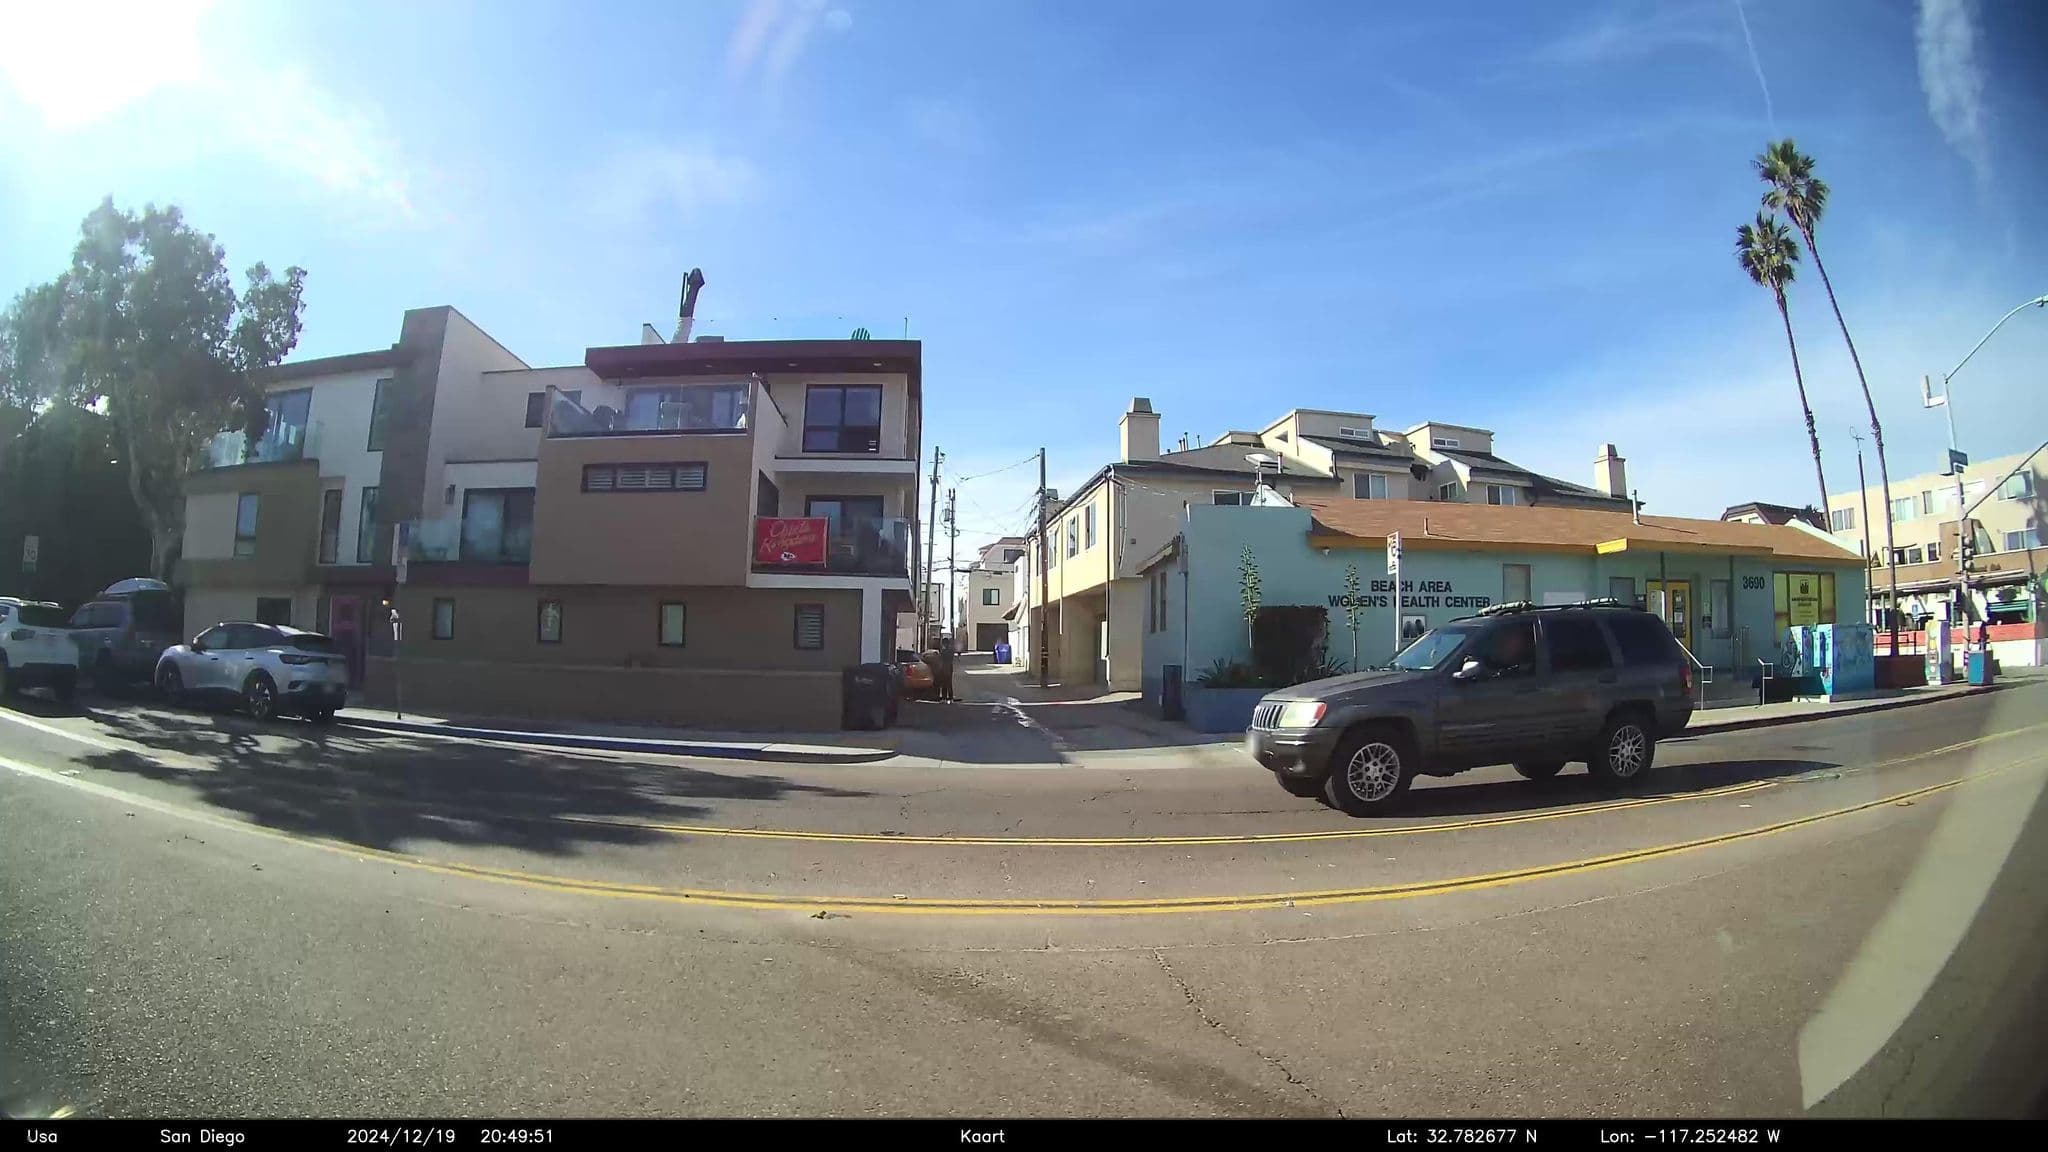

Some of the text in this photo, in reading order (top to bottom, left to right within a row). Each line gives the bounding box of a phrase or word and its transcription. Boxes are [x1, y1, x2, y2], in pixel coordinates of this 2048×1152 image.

[1418, 580, 1453, 593] AREA
[1393, 595, 1440, 608] EALTH
[1445, 596, 1491, 608] CENTER
